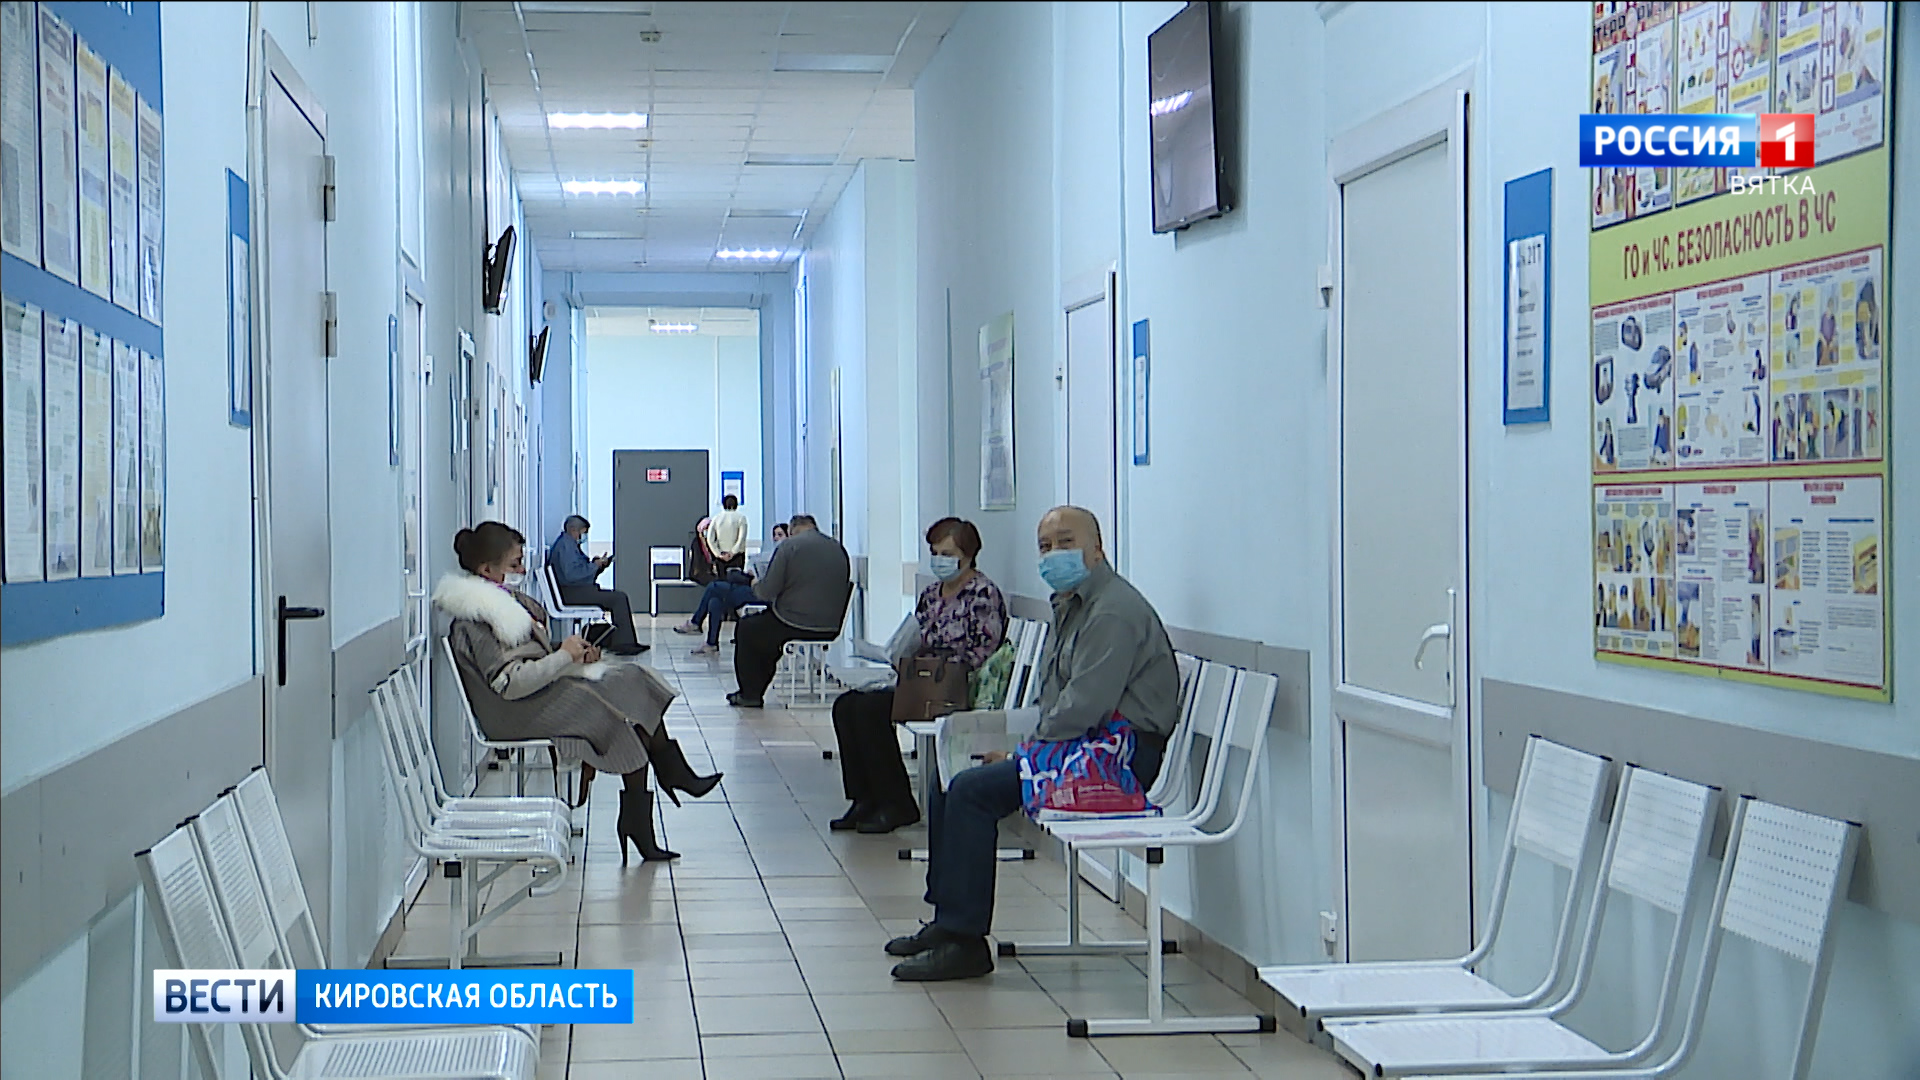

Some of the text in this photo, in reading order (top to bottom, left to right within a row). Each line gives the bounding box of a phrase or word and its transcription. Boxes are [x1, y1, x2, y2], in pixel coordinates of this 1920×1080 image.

[1624, 190, 1836, 280] ГО и ЧС. БЕЗОПАСНОСТЬ В ЧС
